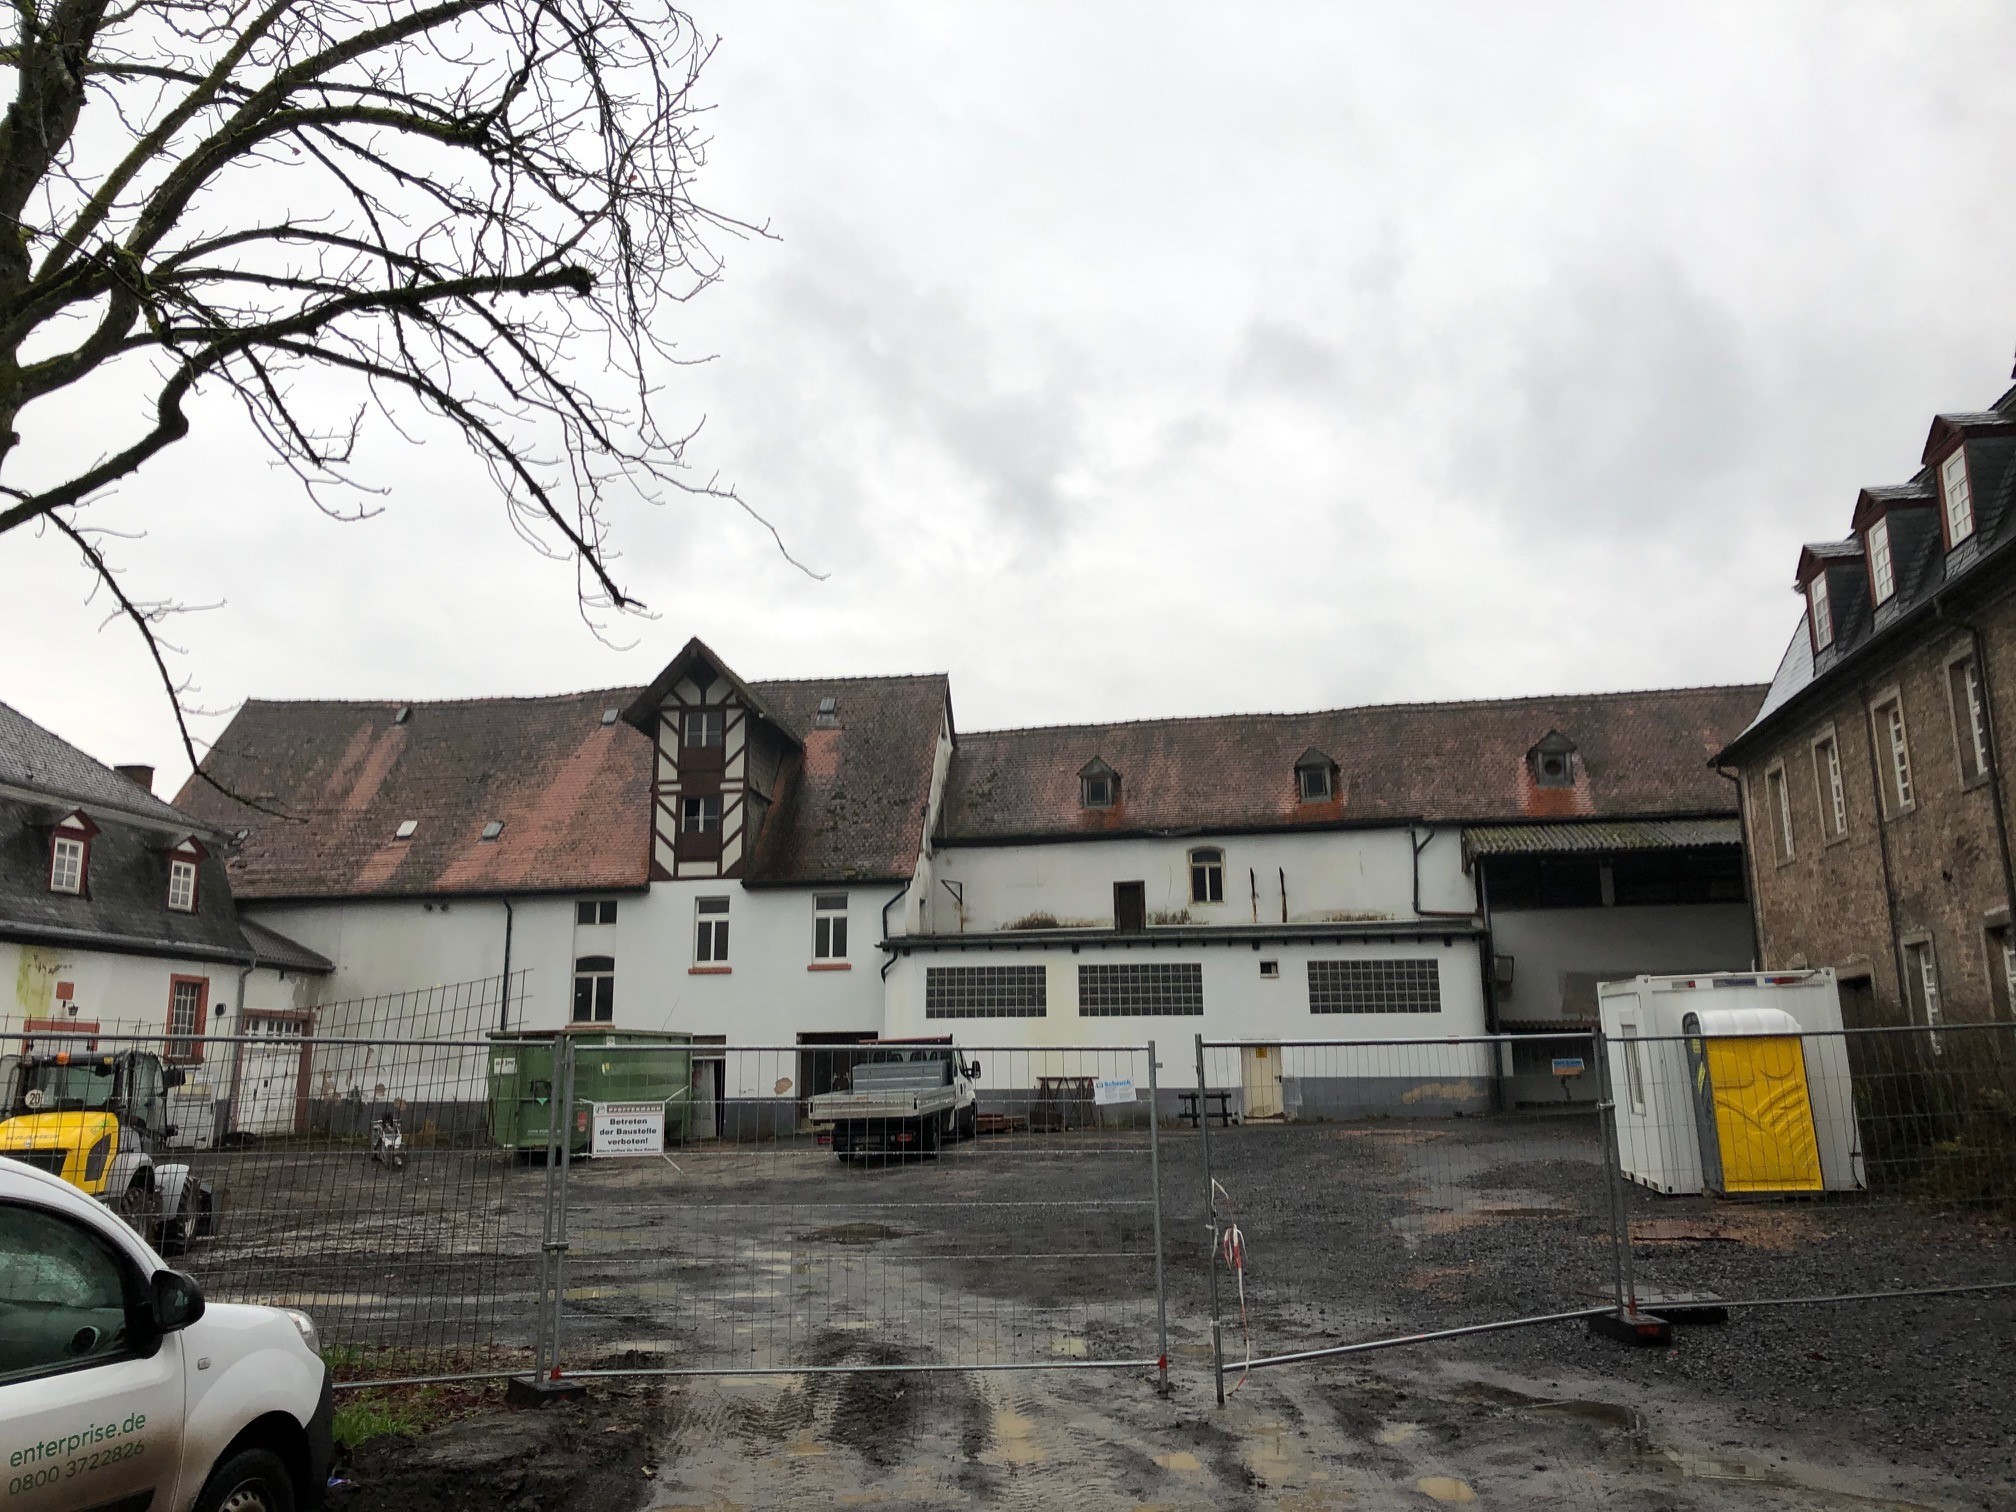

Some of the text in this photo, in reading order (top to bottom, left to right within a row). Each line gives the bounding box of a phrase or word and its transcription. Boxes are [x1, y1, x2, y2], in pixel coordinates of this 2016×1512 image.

[29, 1093, 40, 1105] 20
[599, 1127, 657, 1136] der Baustelle
[607, 1137, 648, 1145] verboten!
[10, 1412, 146, 1467] enterprise.de
[9, 1440, 146, 1494] 0800 3722826
